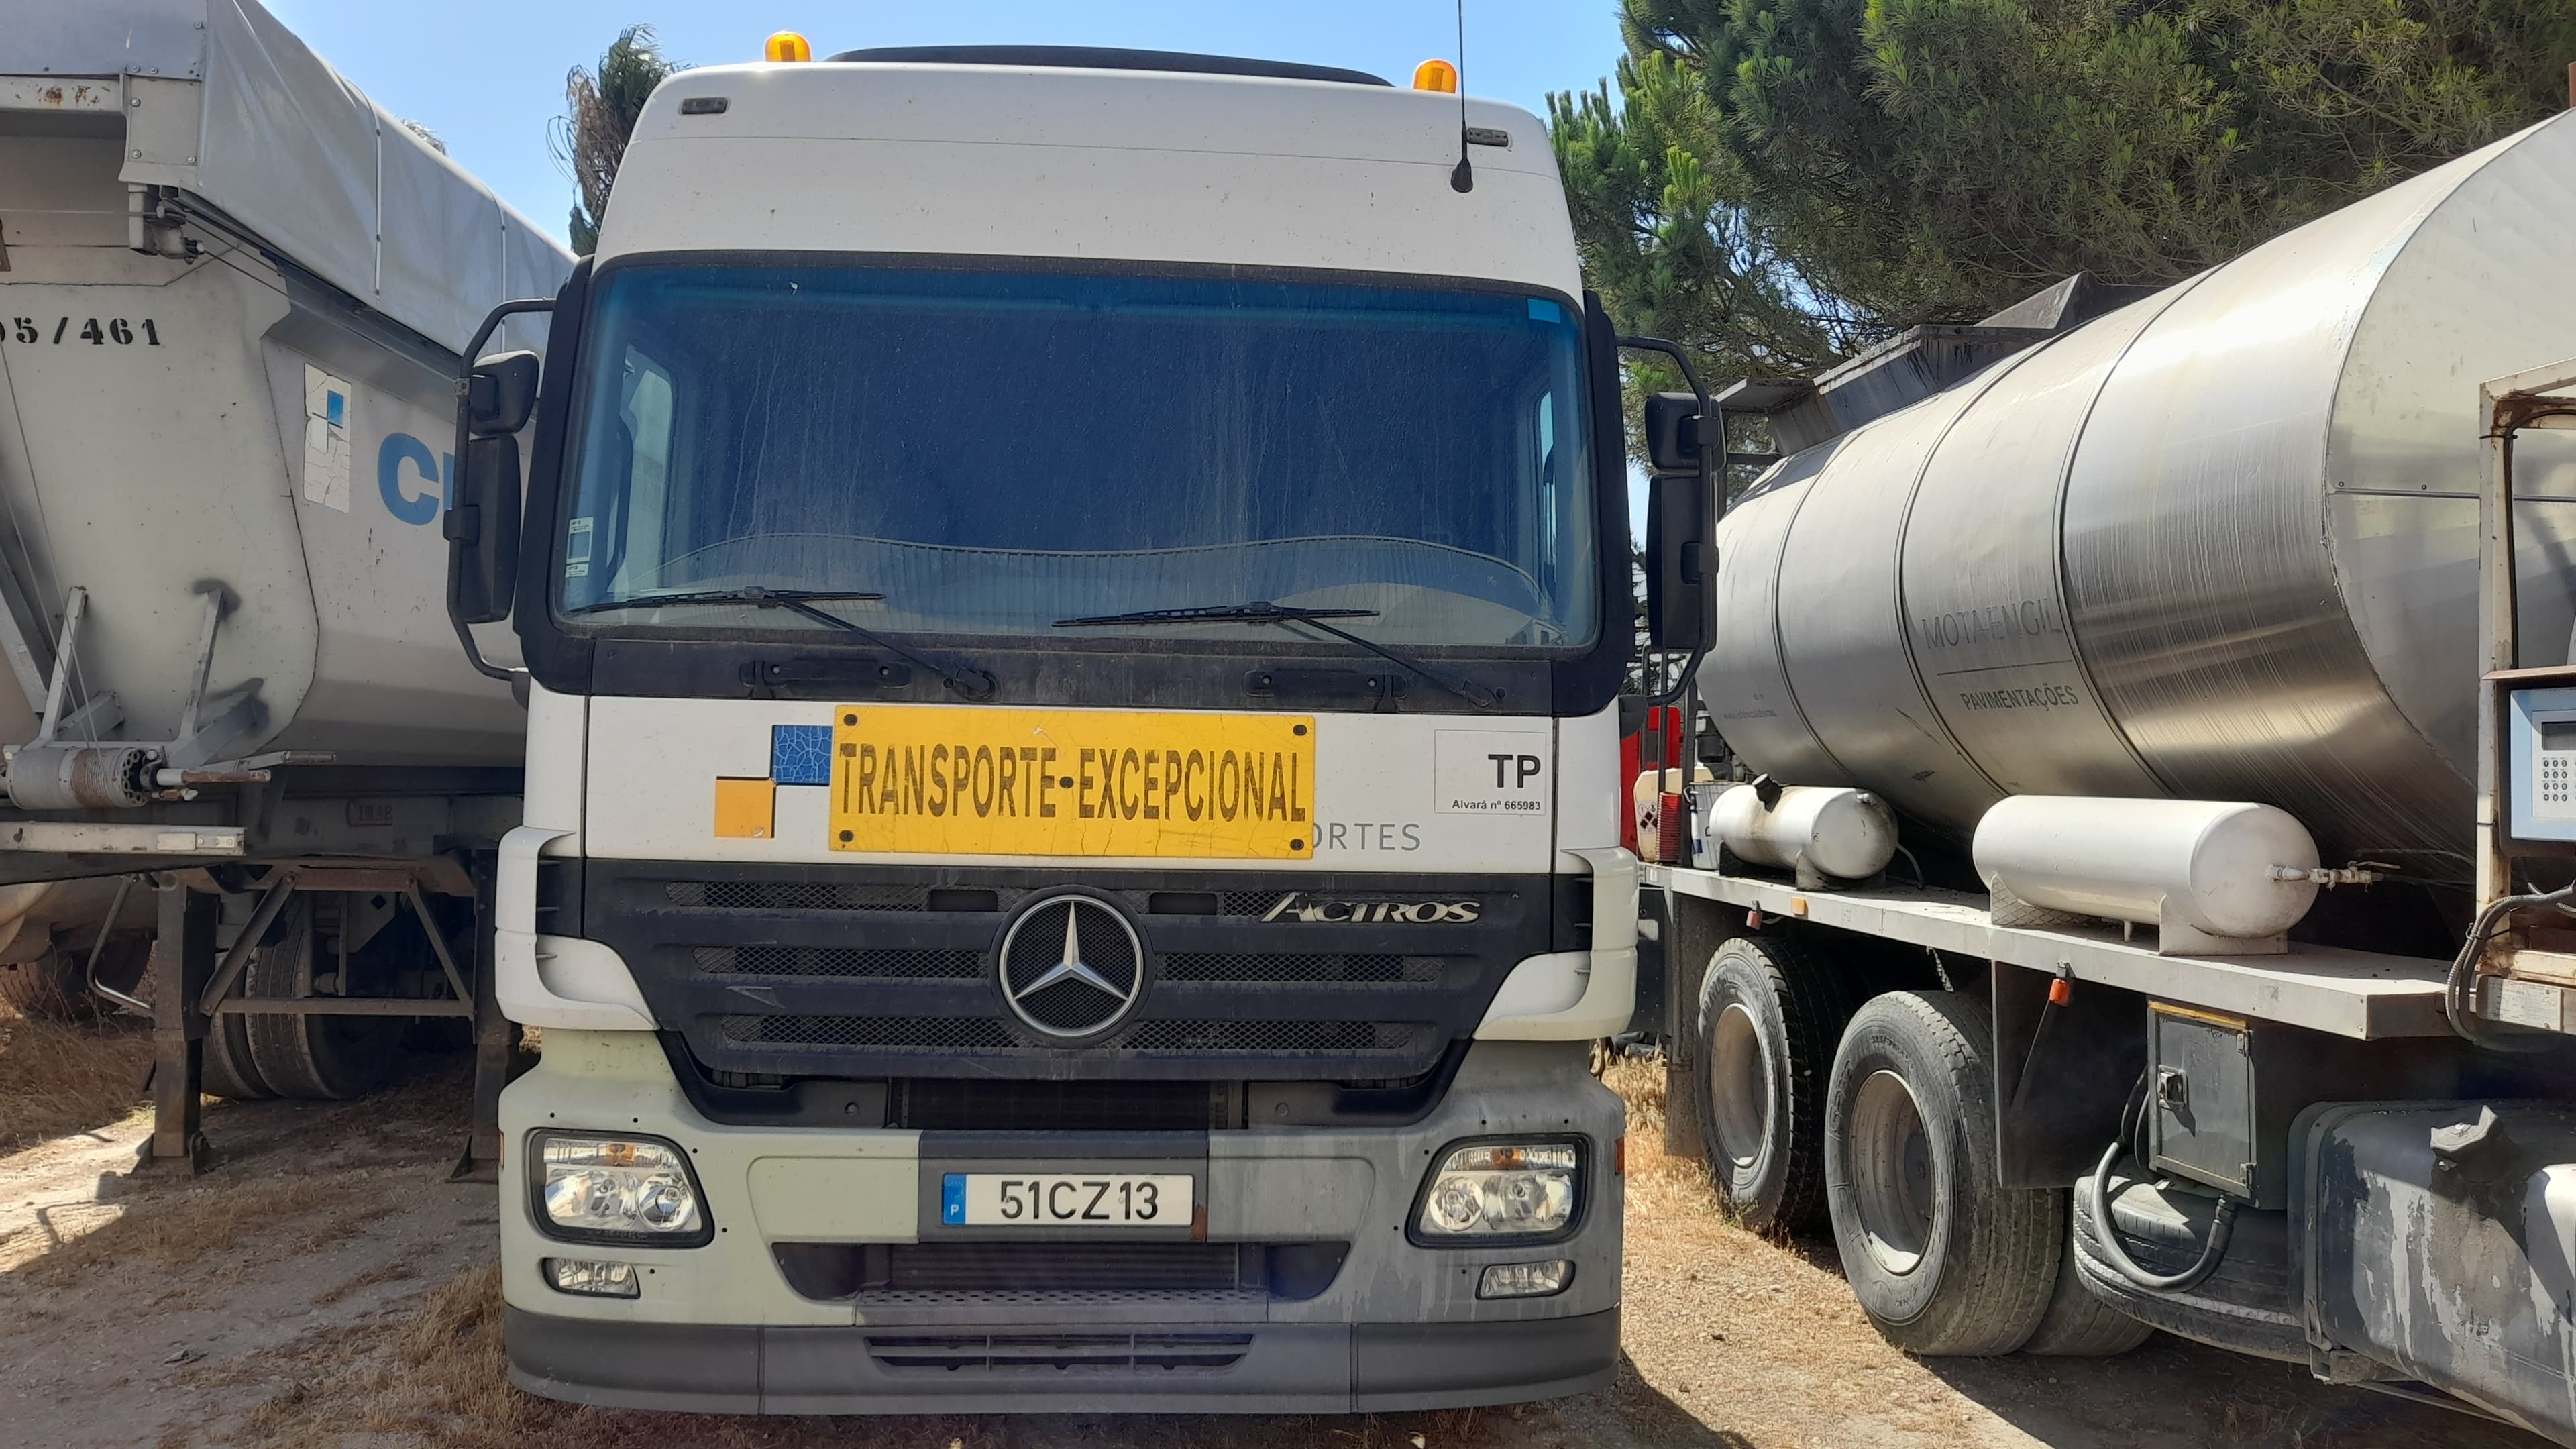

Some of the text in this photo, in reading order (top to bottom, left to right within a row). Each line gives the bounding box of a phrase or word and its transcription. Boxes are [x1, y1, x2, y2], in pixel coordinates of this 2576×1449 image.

[0, 317, 160, 345] 5/461
[1960, 683, 2078, 712] PAVIMENTAÇÕES
[839, 743, 1306, 822] TRANSPORTE EXCEPCIONAL
[1487, 753, 1541, 788] TP
[1452, 799, 1487, 810] Alvará
[1504, 800, 1541, 811] 665983
[949, 1203, 960, 1216] P
